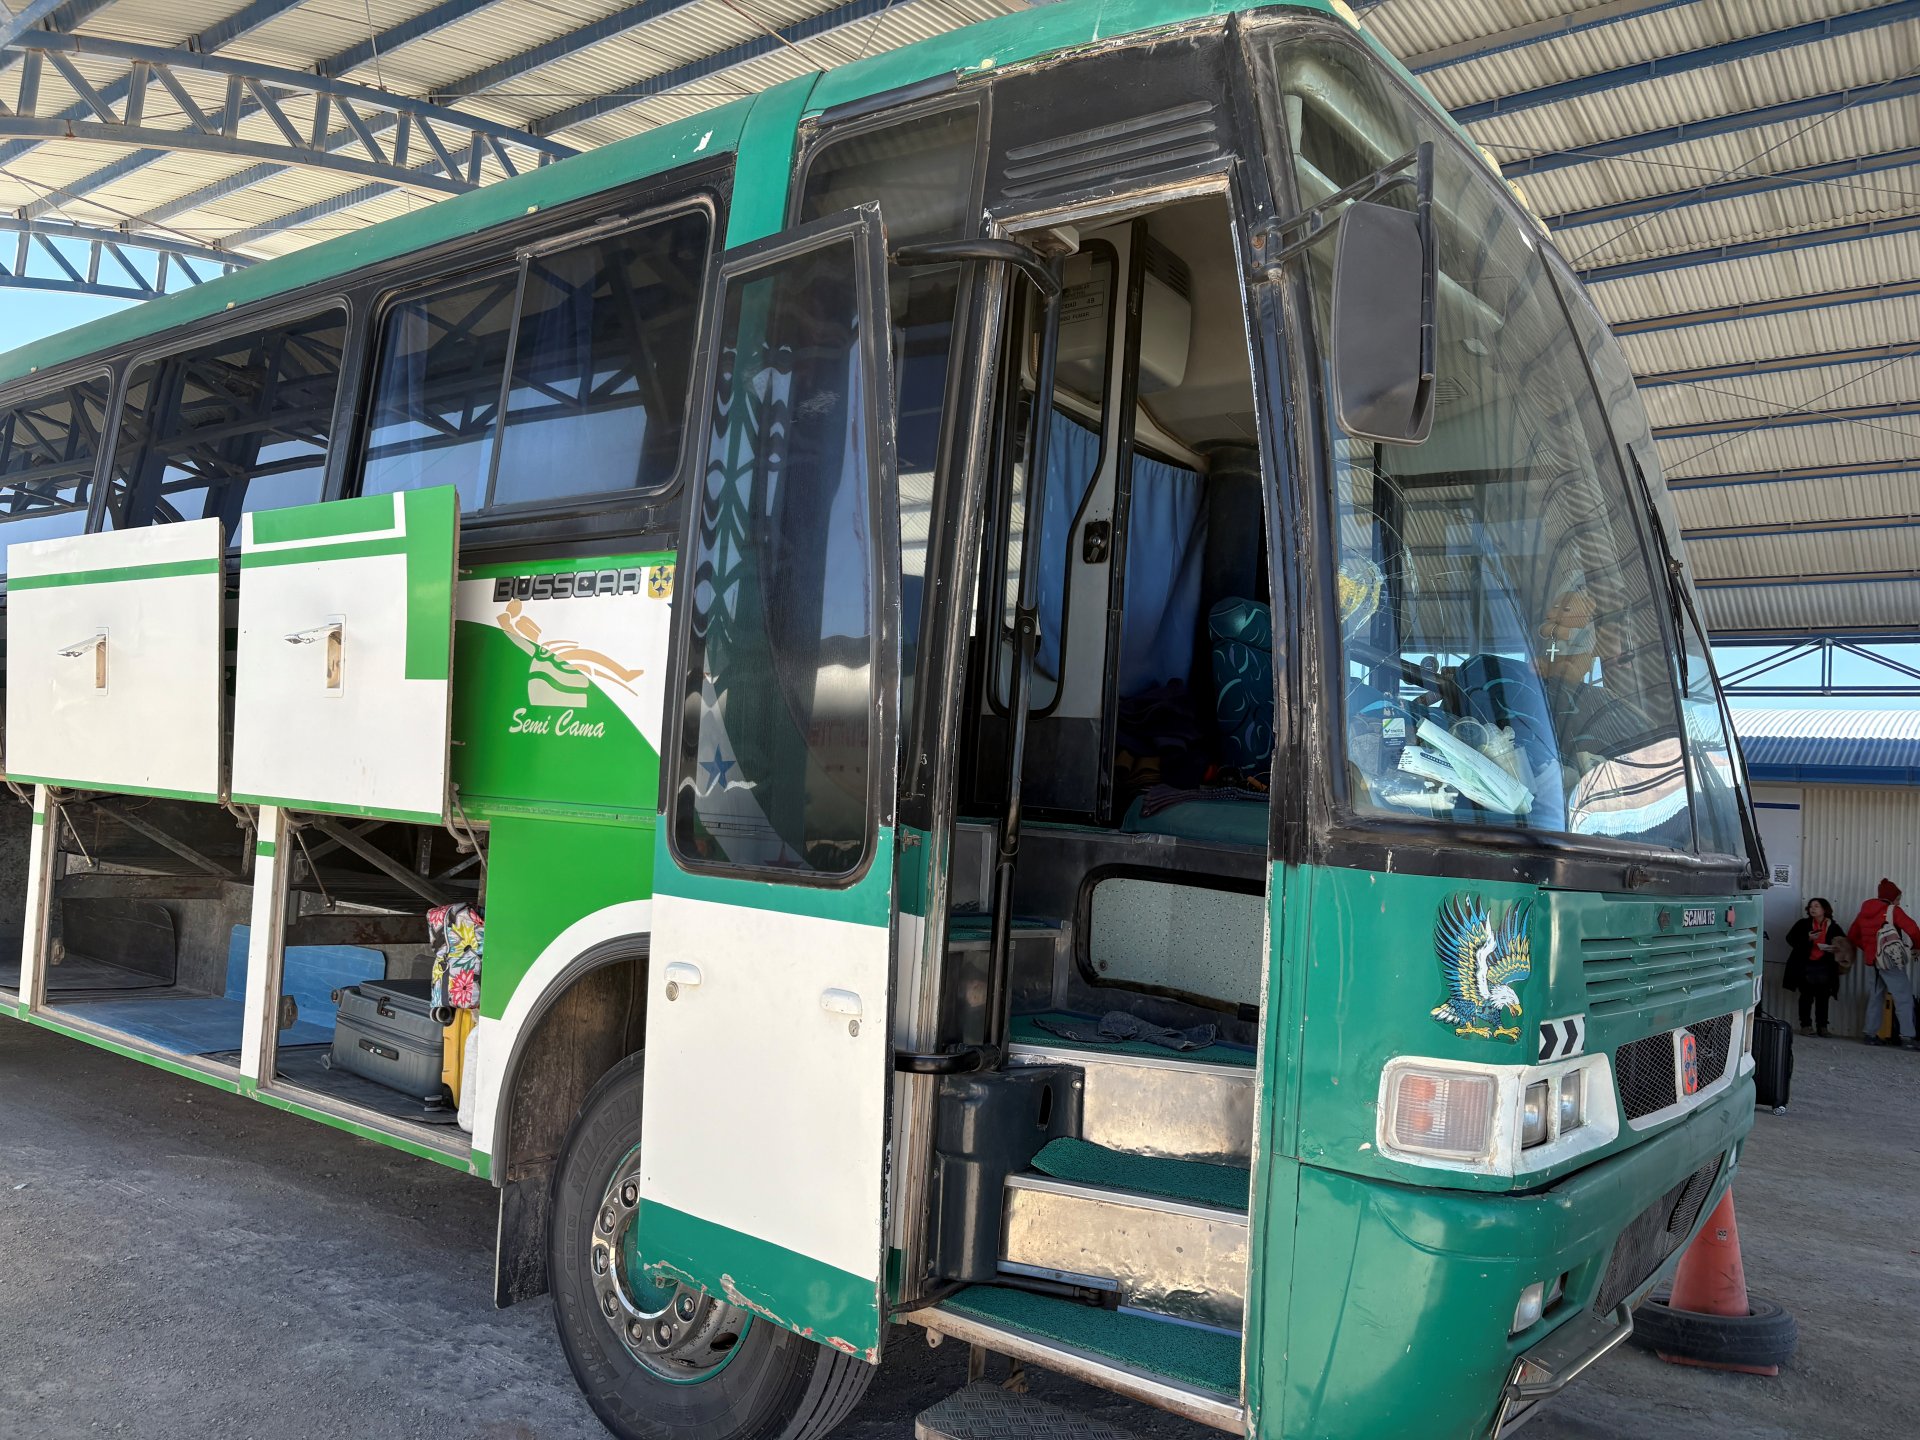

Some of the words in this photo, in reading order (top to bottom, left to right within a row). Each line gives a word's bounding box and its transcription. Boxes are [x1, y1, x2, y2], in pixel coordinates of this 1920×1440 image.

[493, 567, 641, 602] BUSSCAR
[509, 708, 551, 734] Semi
[555, 709, 605, 739] Cama
[1684, 910, 1707, 927] SCANIA
